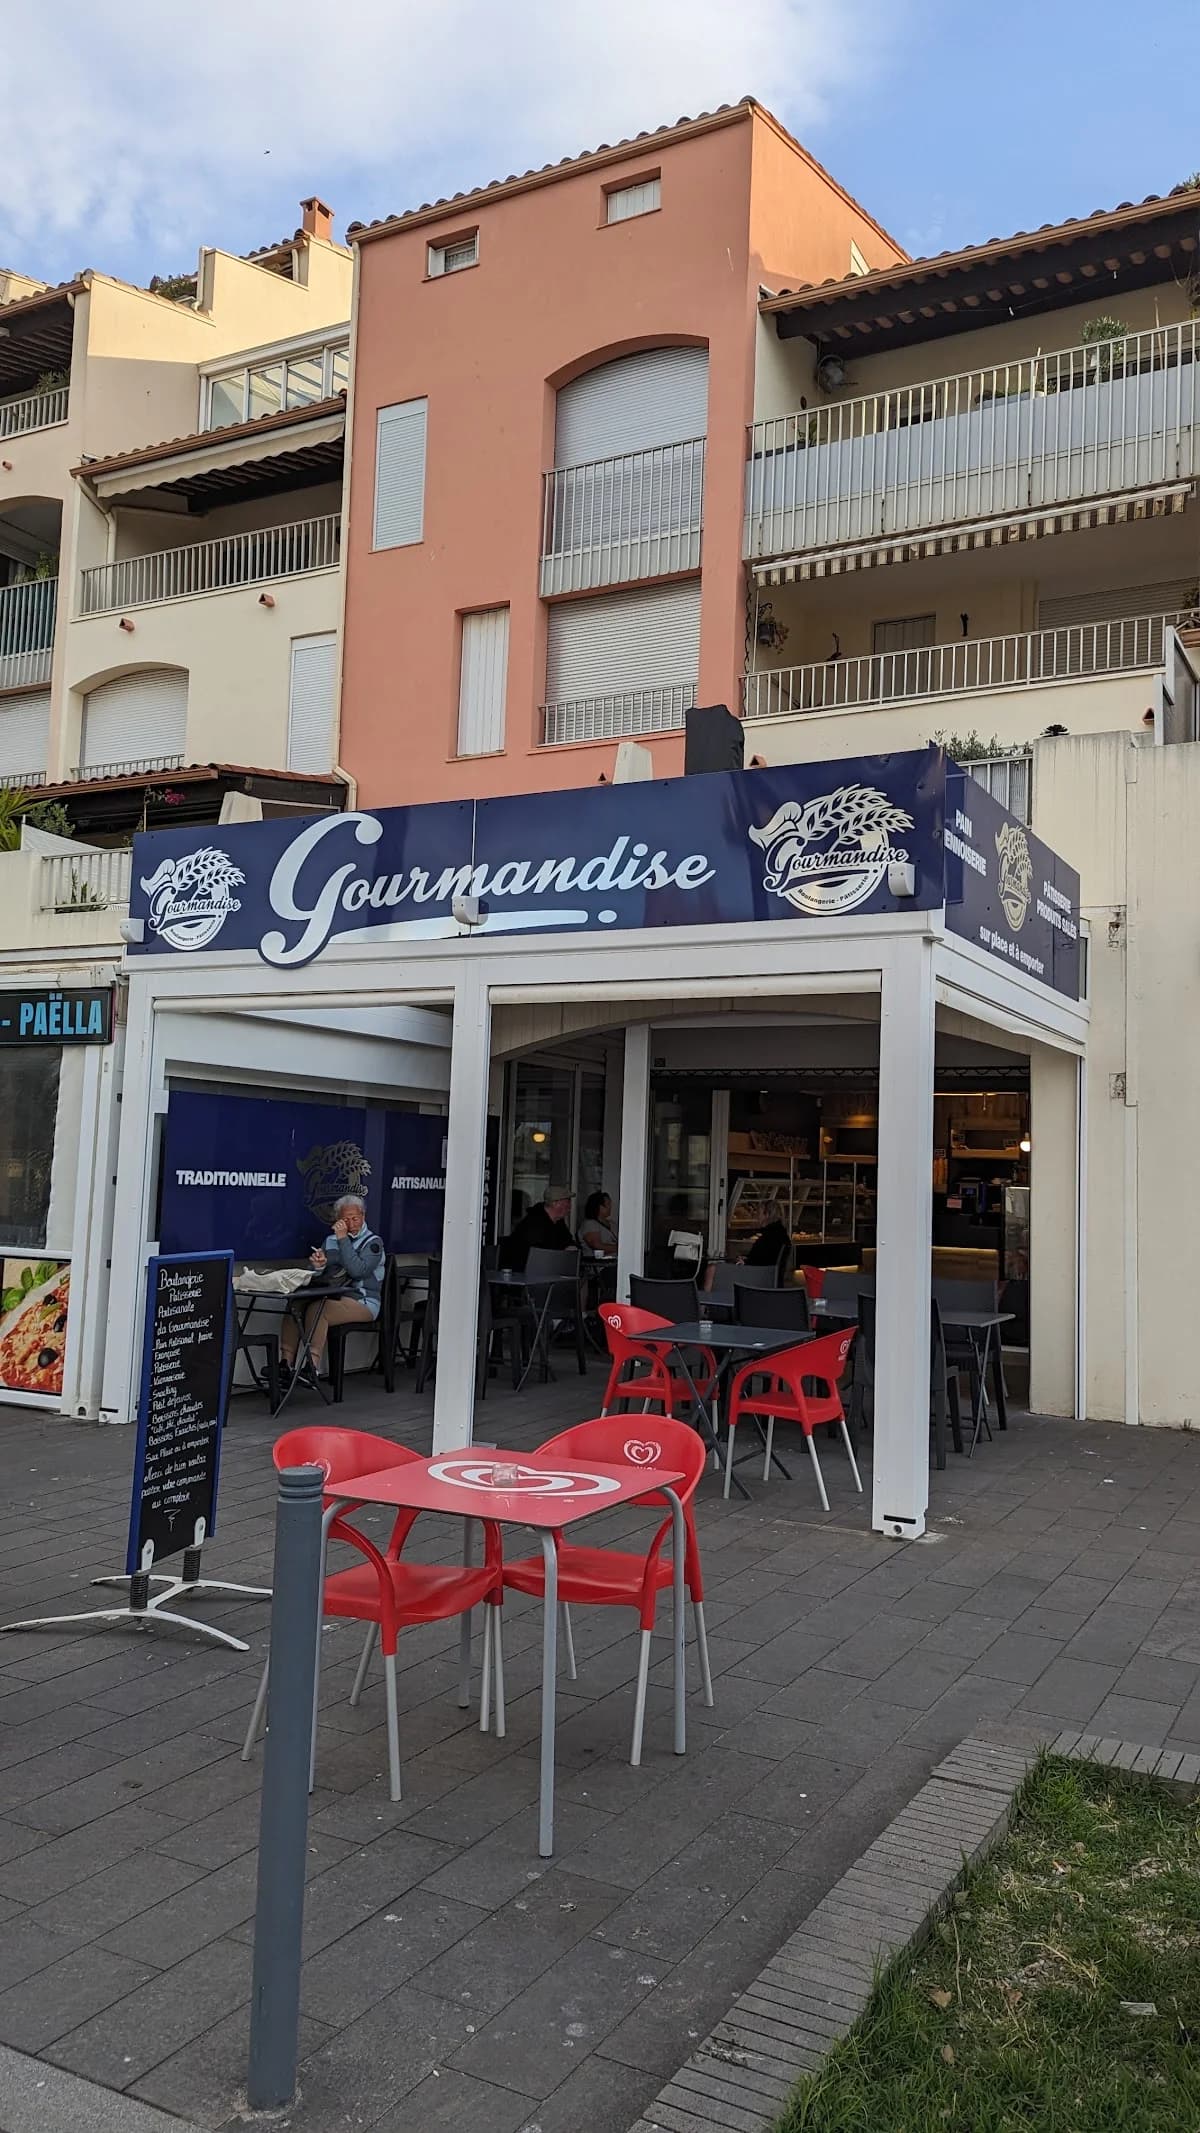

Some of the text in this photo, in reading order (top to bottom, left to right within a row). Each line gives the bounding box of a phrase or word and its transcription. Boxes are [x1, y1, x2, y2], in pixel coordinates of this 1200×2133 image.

[955, 809, 972, 838] PAIN
[764, 834, 908, 890] Gourmandise
[149, 884, 242, 930] Gourmandise
[257, 812, 716, 964] Gourmandise
[797, 889, 836, 905] Boulangerie
[1043, 880, 1072, 915] PÂTISSERIE
[1036, 898, 1062, 930] PRODUITS
[979, 925, 1045, 975] sur place et à emporter
[19, 993, 103, 1036] PAËLLA
[175, 1169, 287, 1188] TRADITIONNELLE
[482, 1156, 491, 1247] TRADITI
